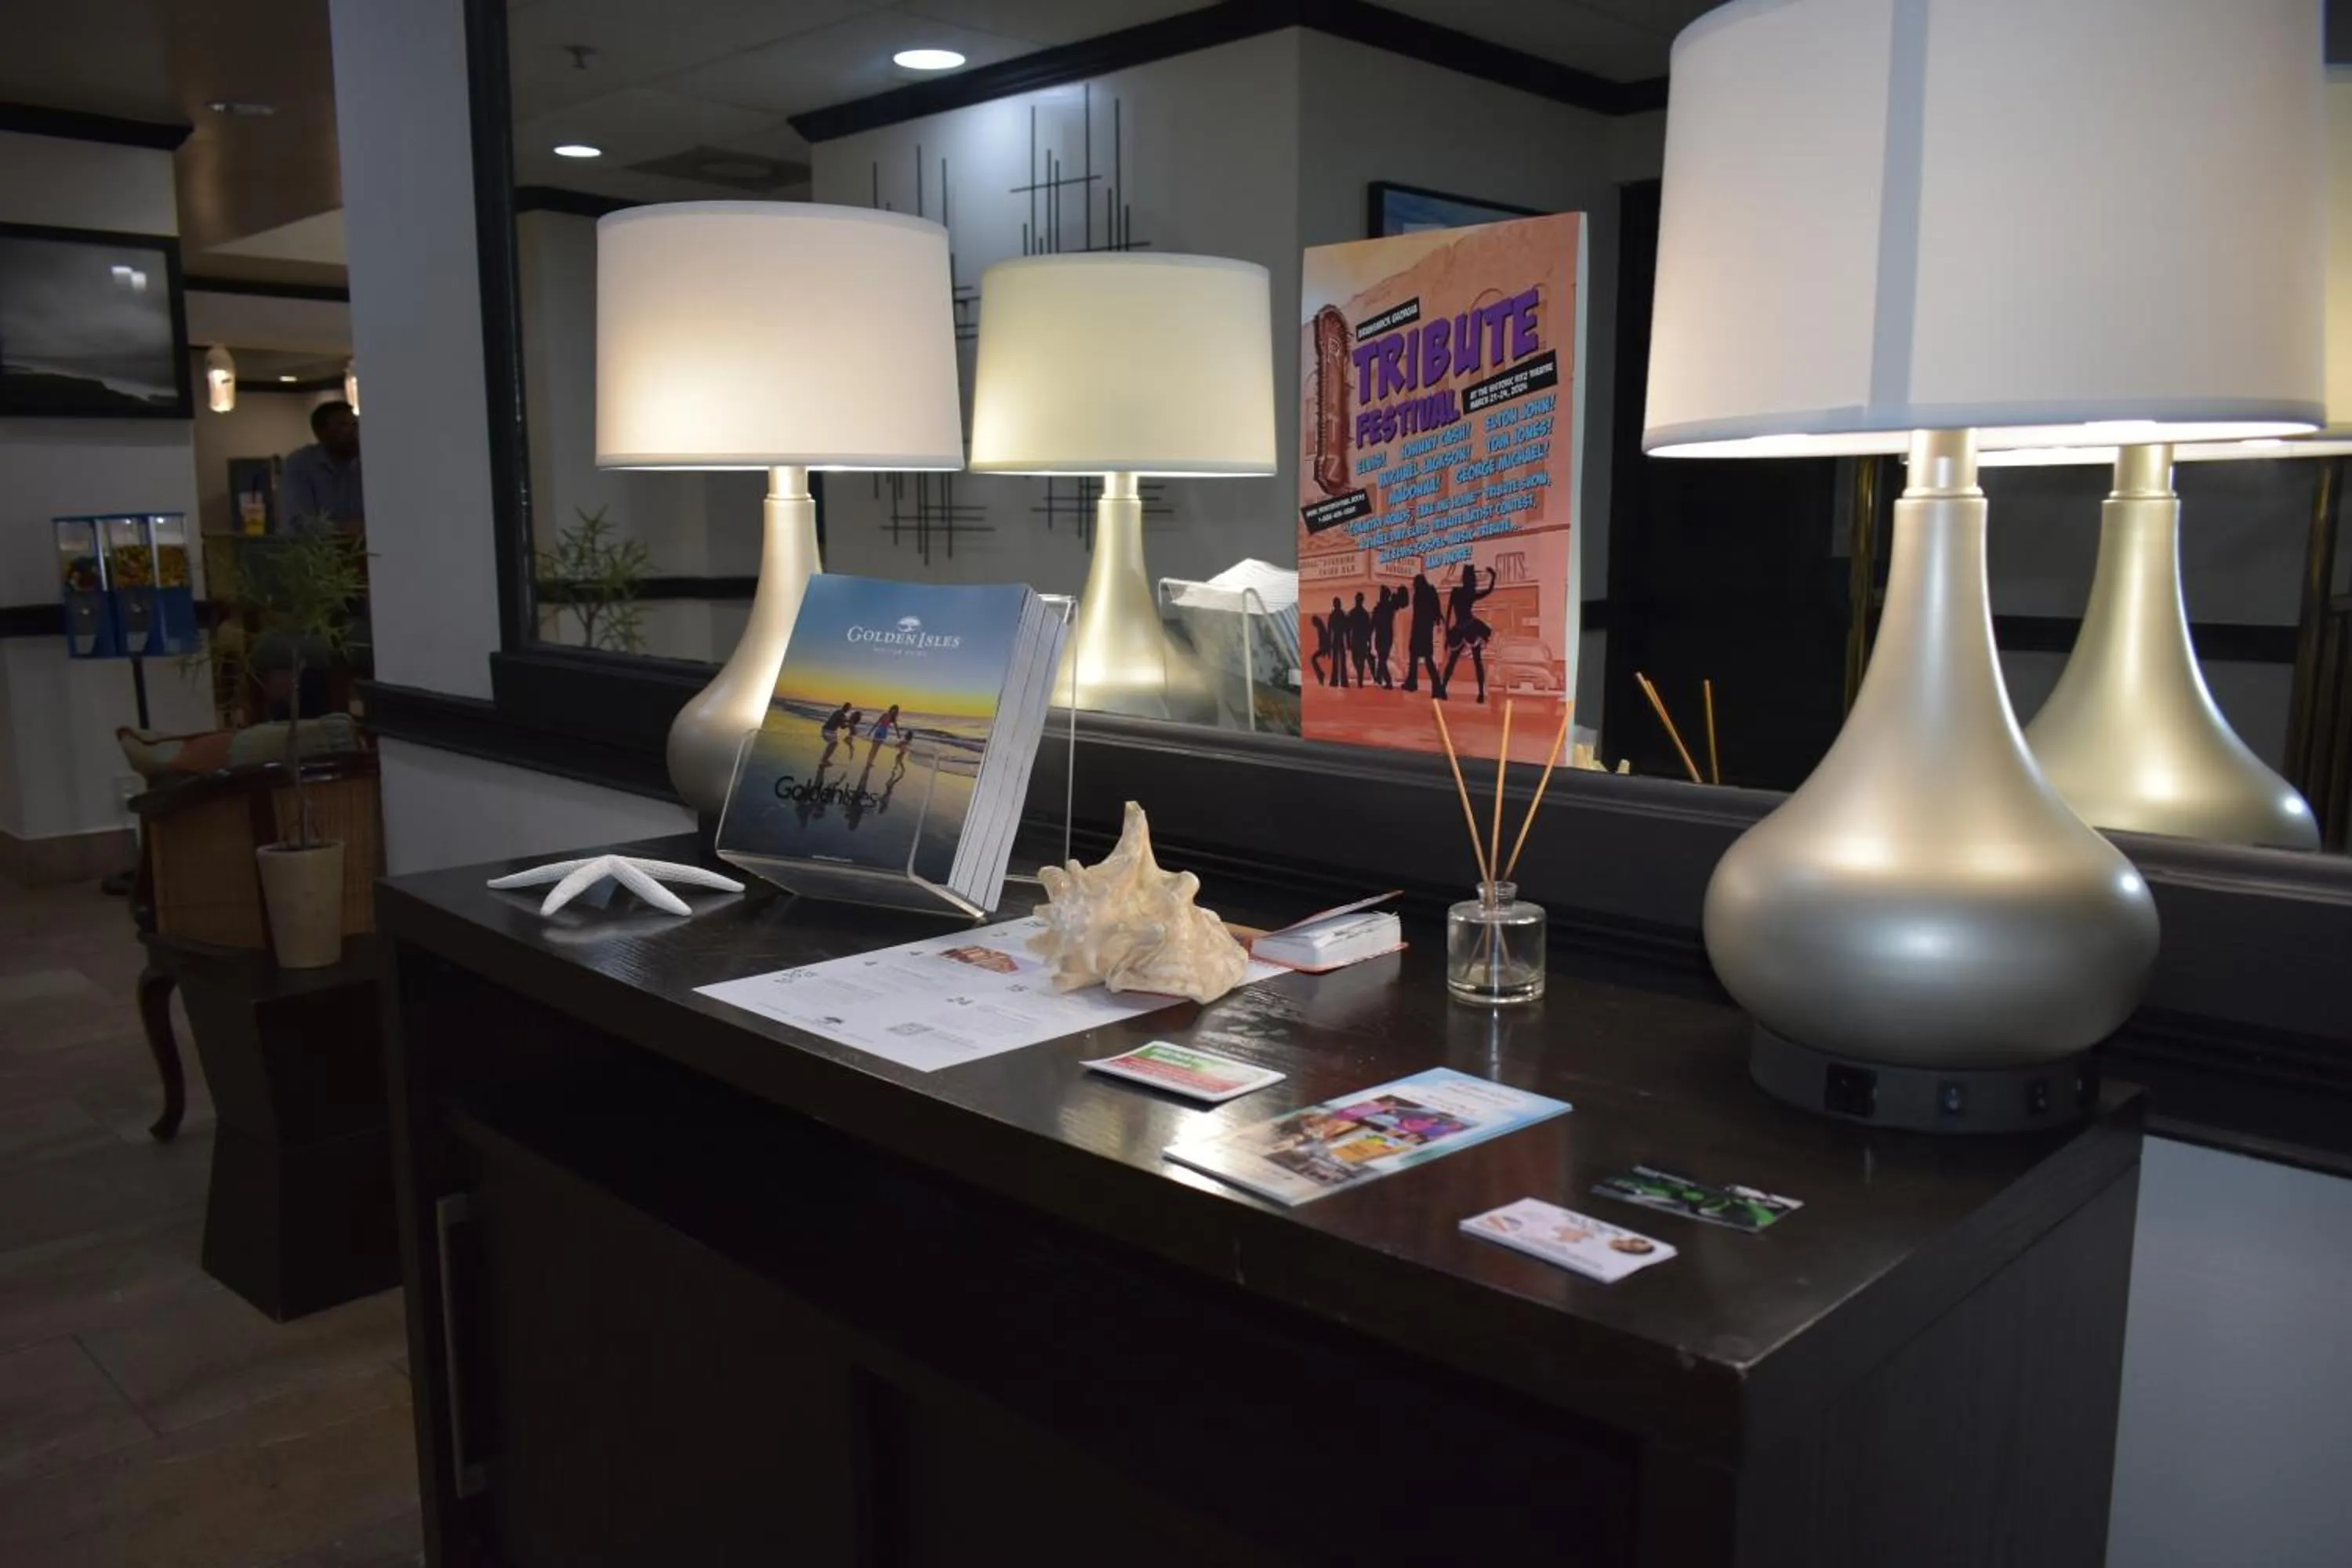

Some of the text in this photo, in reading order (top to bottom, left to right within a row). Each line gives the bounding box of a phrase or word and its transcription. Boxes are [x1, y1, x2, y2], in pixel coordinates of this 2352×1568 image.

[1353, 287, 1538, 405] TRIBUTE
[1356, 389, 1461, 449] FESTIVAL
[1485, 394, 1555, 432] ELTON JOHN!
[1400, 434, 1439, 460] JOHNNY
[1486, 417, 1553, 452] TOM JONES!
[1379, 462, 1419, 488] MICHAEL
[1455, 440, 1549, 484] GEORGE MICHAEL!
[1388, 474, 1441, 506] MADONNA!
[1495, 551, 1526, 583] GIFTS
[847, 624, 961, 648] GOLDEN ISLES
